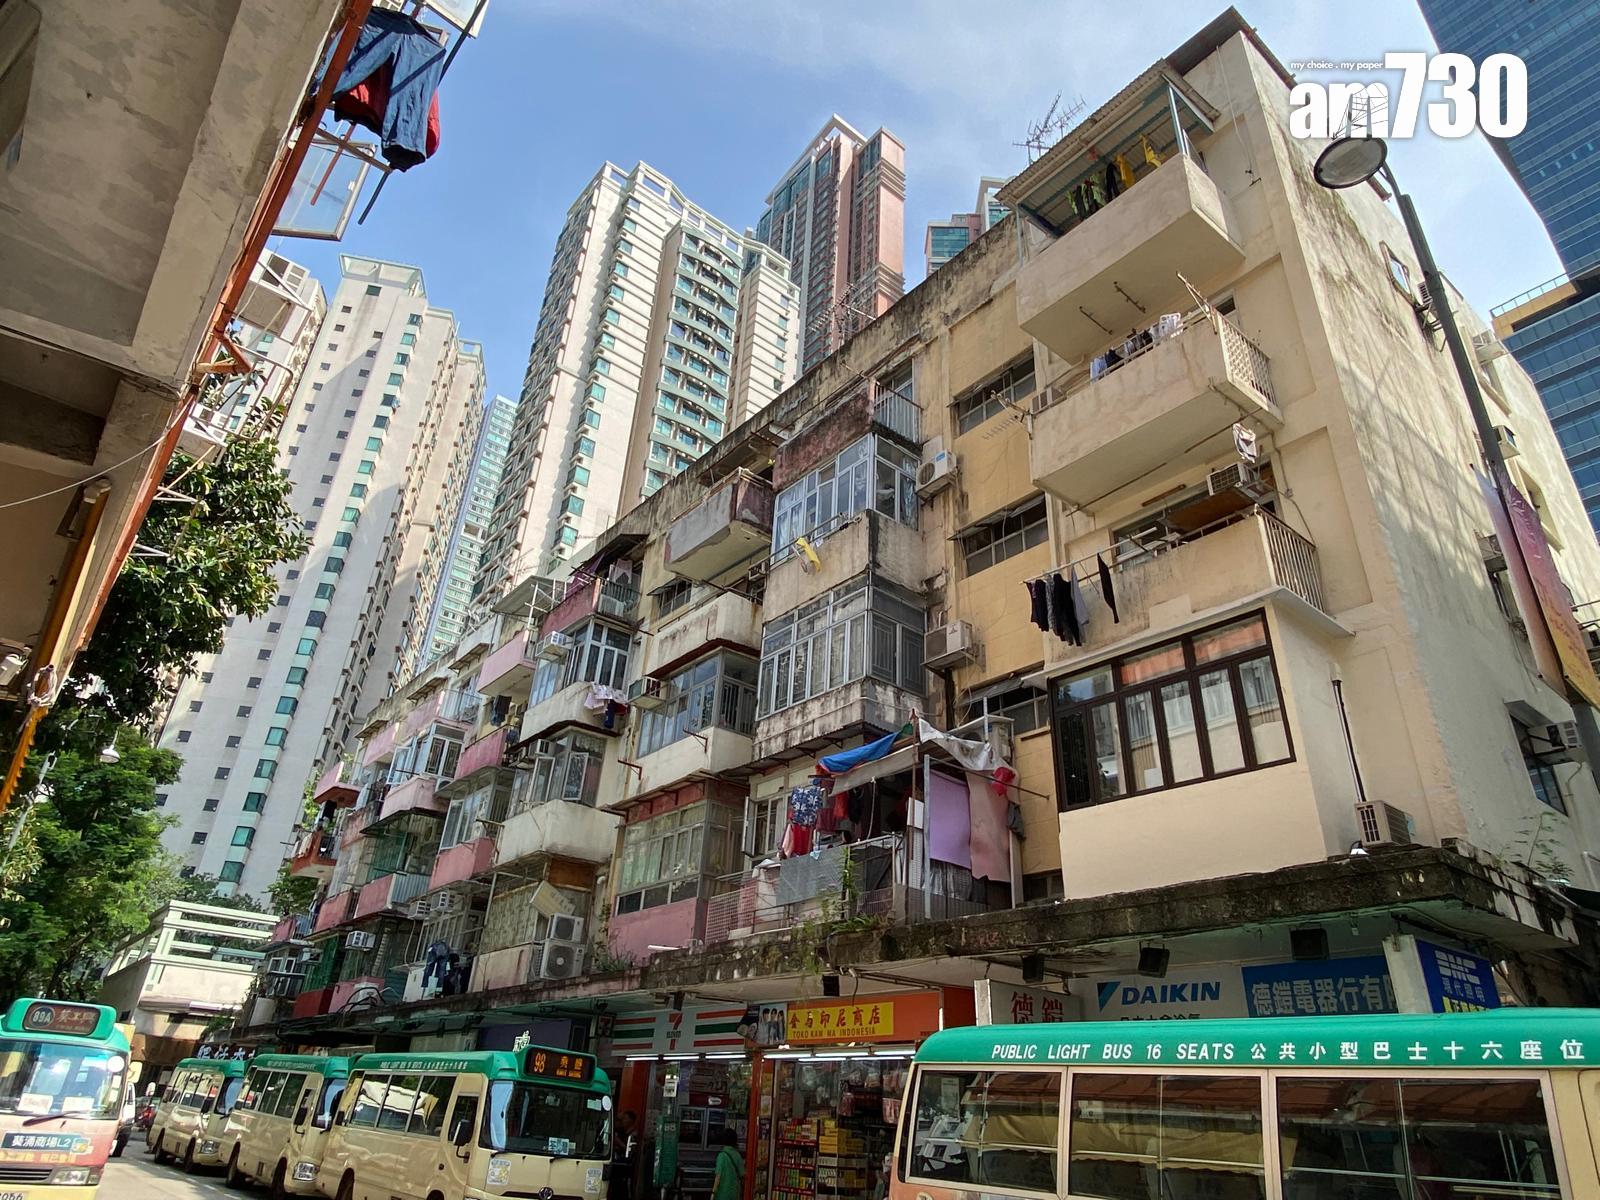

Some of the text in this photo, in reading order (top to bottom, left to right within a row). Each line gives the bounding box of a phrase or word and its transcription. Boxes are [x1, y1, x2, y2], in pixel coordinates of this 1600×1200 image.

[1121, 981, 1221, 1006] DAIKIN
[32, 1010, 52, 1023] 89A
[839, 1027, 876, 1036] INDONESIA
[992, 1038, 1585, 1061] PUBLIC LIGHT BUS 16 SEATS 公共小型巴士十六座位
[534, 1052, 546, 1073] 98
